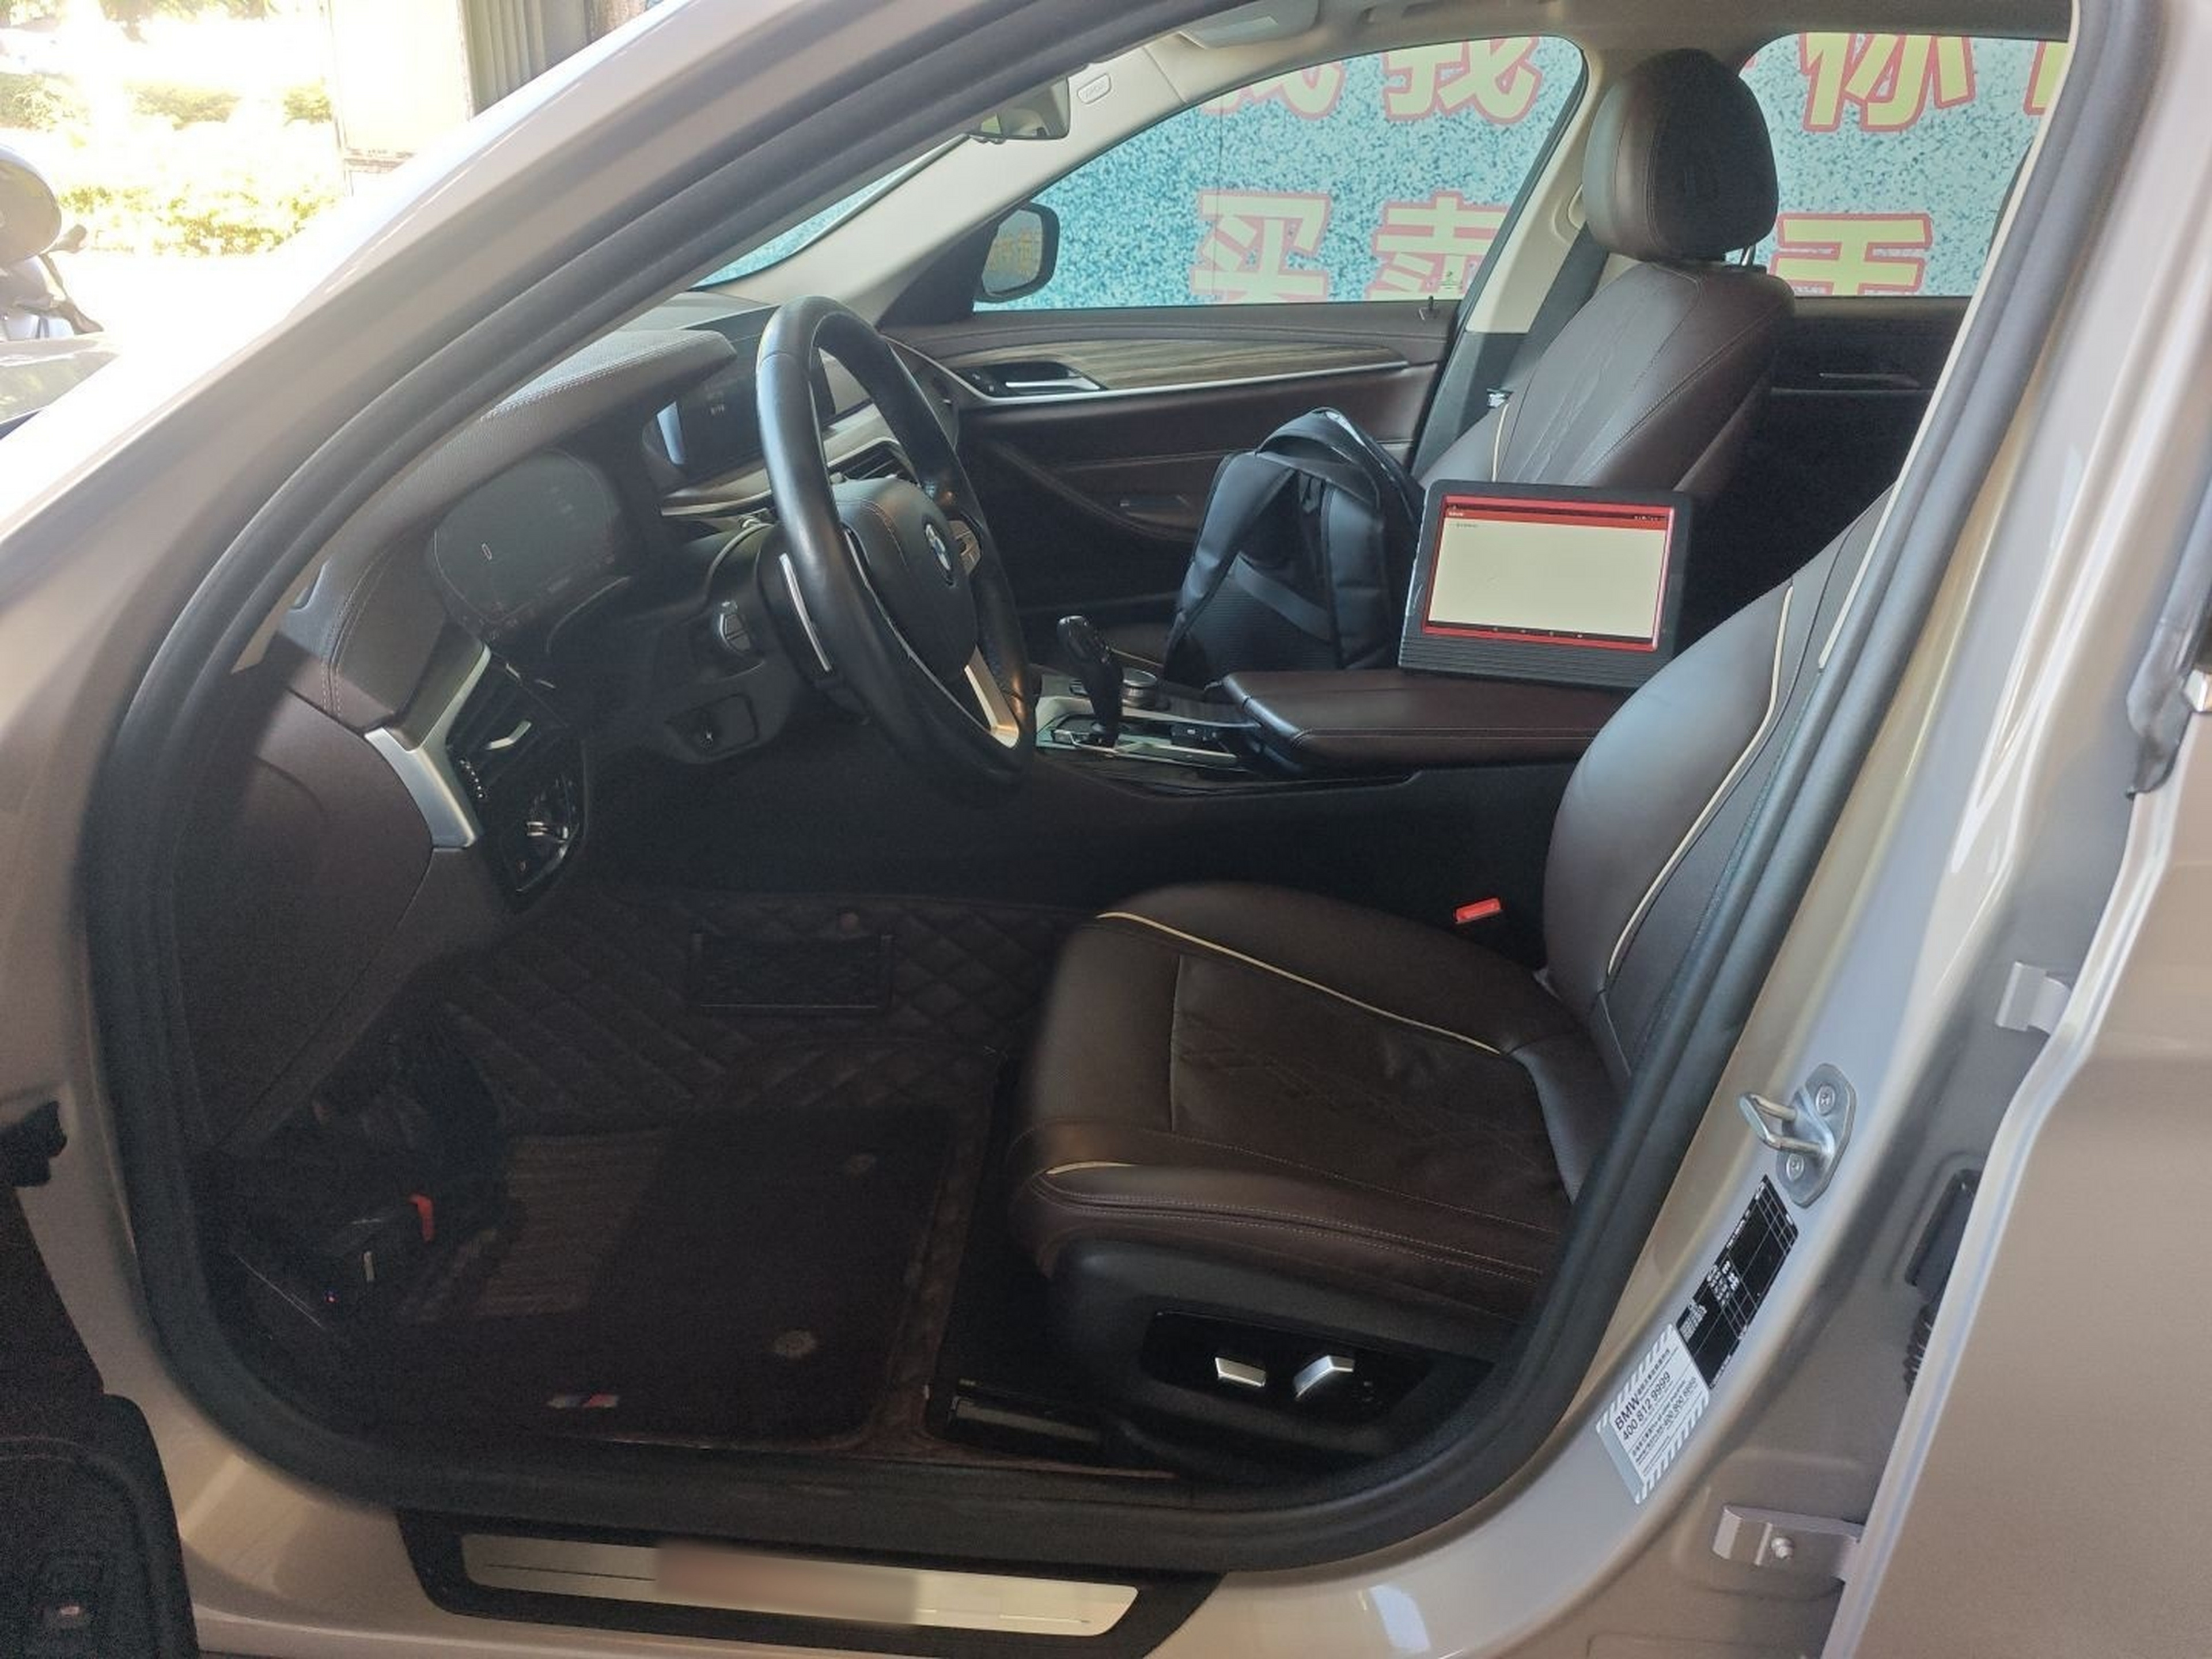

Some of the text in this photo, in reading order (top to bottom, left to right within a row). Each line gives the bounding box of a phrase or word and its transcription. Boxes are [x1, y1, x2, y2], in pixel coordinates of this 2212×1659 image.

[1615, 1393, 1640, 1431] BMW
[1623, 1419, 1638, 1440] 400
[1637, 1398, 1653, 1422] 812
[1650, 1370, 1671, 1402] 9999
